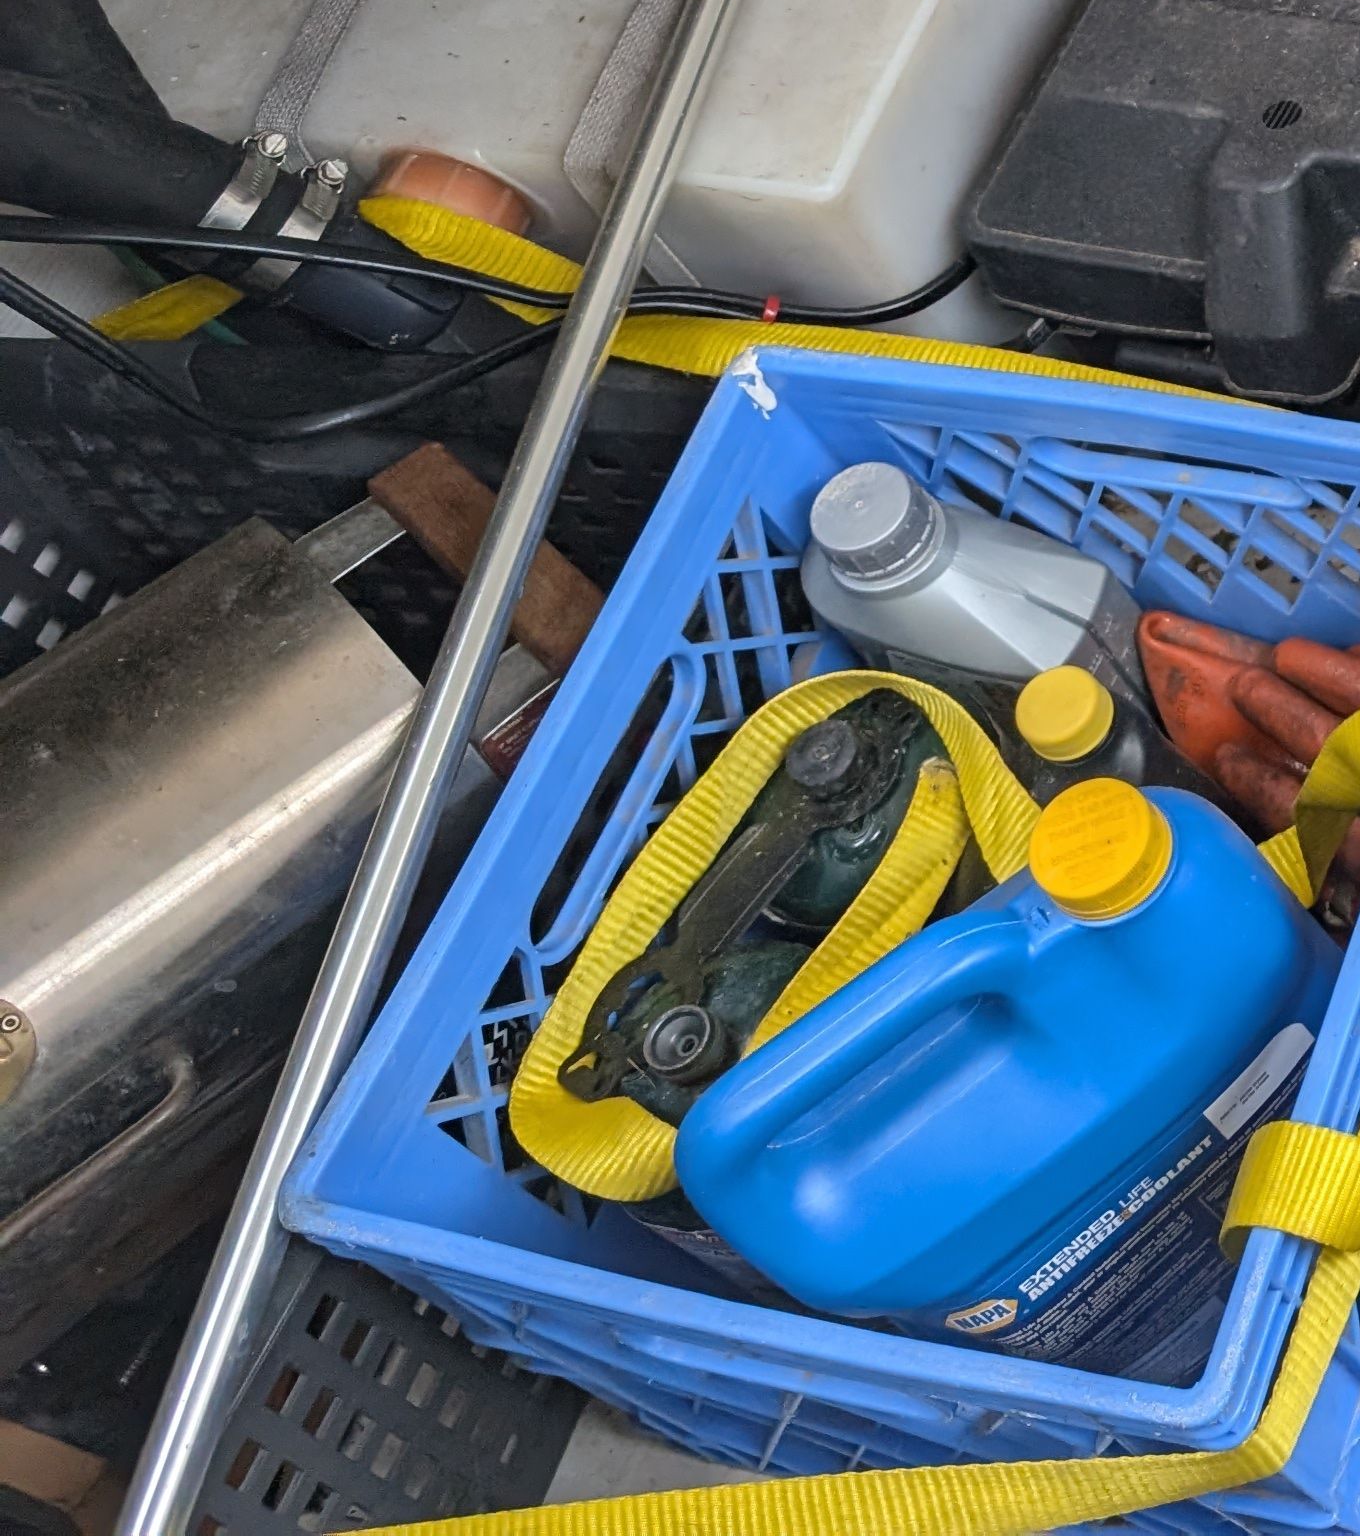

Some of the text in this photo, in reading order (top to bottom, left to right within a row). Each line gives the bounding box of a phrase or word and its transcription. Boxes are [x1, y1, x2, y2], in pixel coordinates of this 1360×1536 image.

[1018, 1175, 1155, 1294] EXTENDED LIFE
[1027, 1134, 1214, 1303] ANTIFREEZE COOLANT
[954, 1302, 1012, 1332] NAPA
